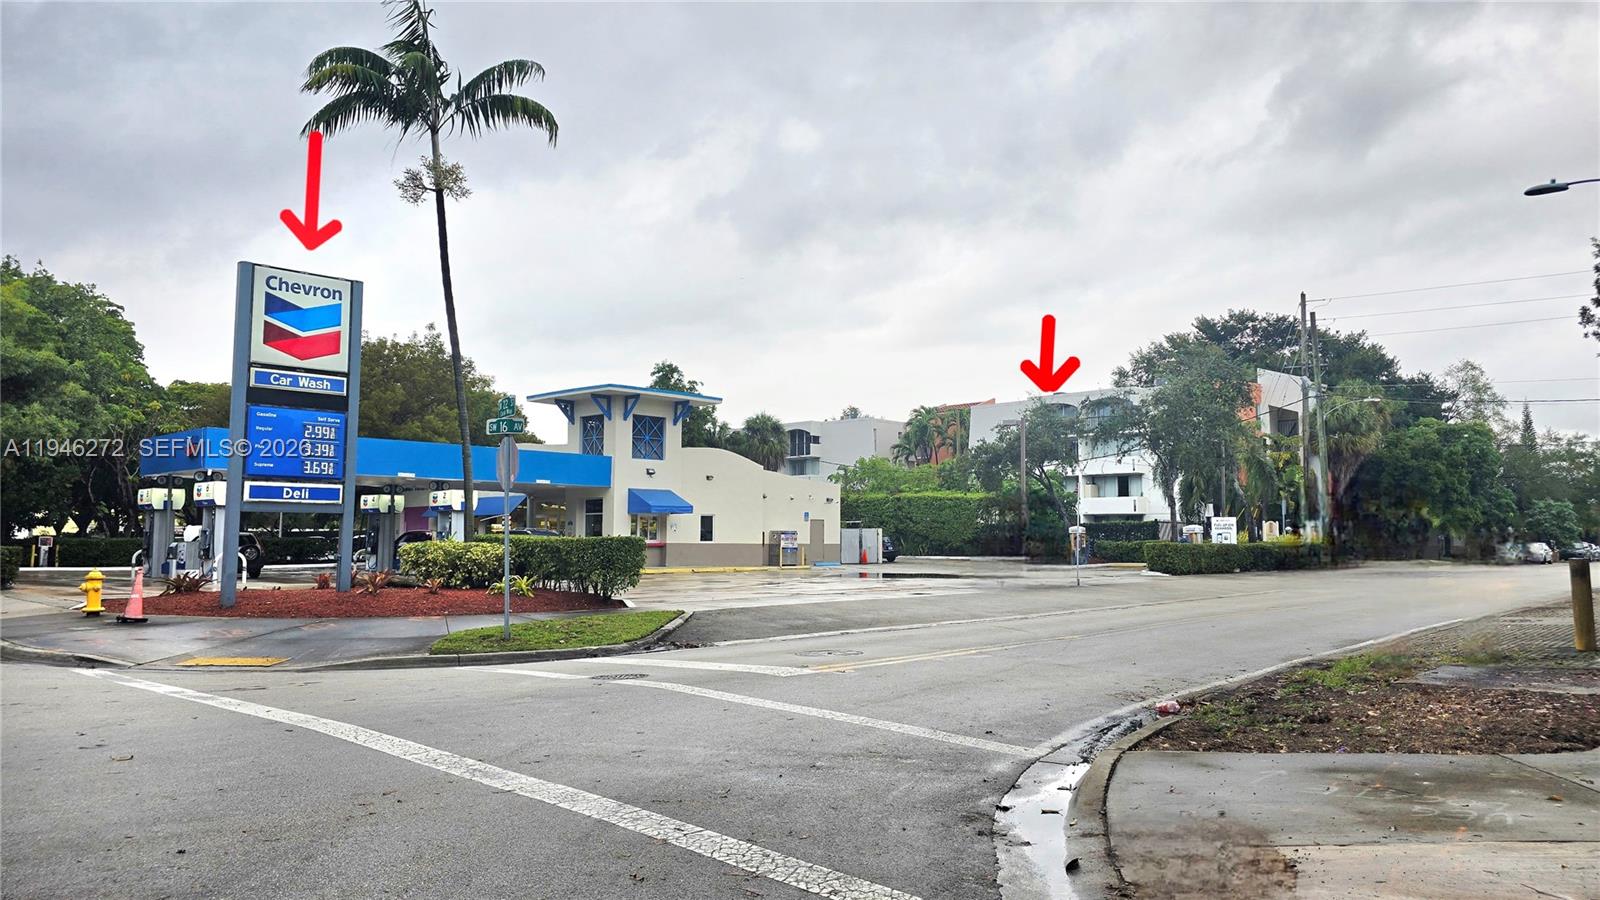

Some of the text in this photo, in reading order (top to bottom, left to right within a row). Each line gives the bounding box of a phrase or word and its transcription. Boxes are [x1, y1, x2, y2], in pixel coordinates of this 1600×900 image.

[265, 275, 342, 301] Chevron
[270, 374, 331, 389] Car Wash
[500, 421, 508, 433] 16
[282, 487, 310, 499] Deli
